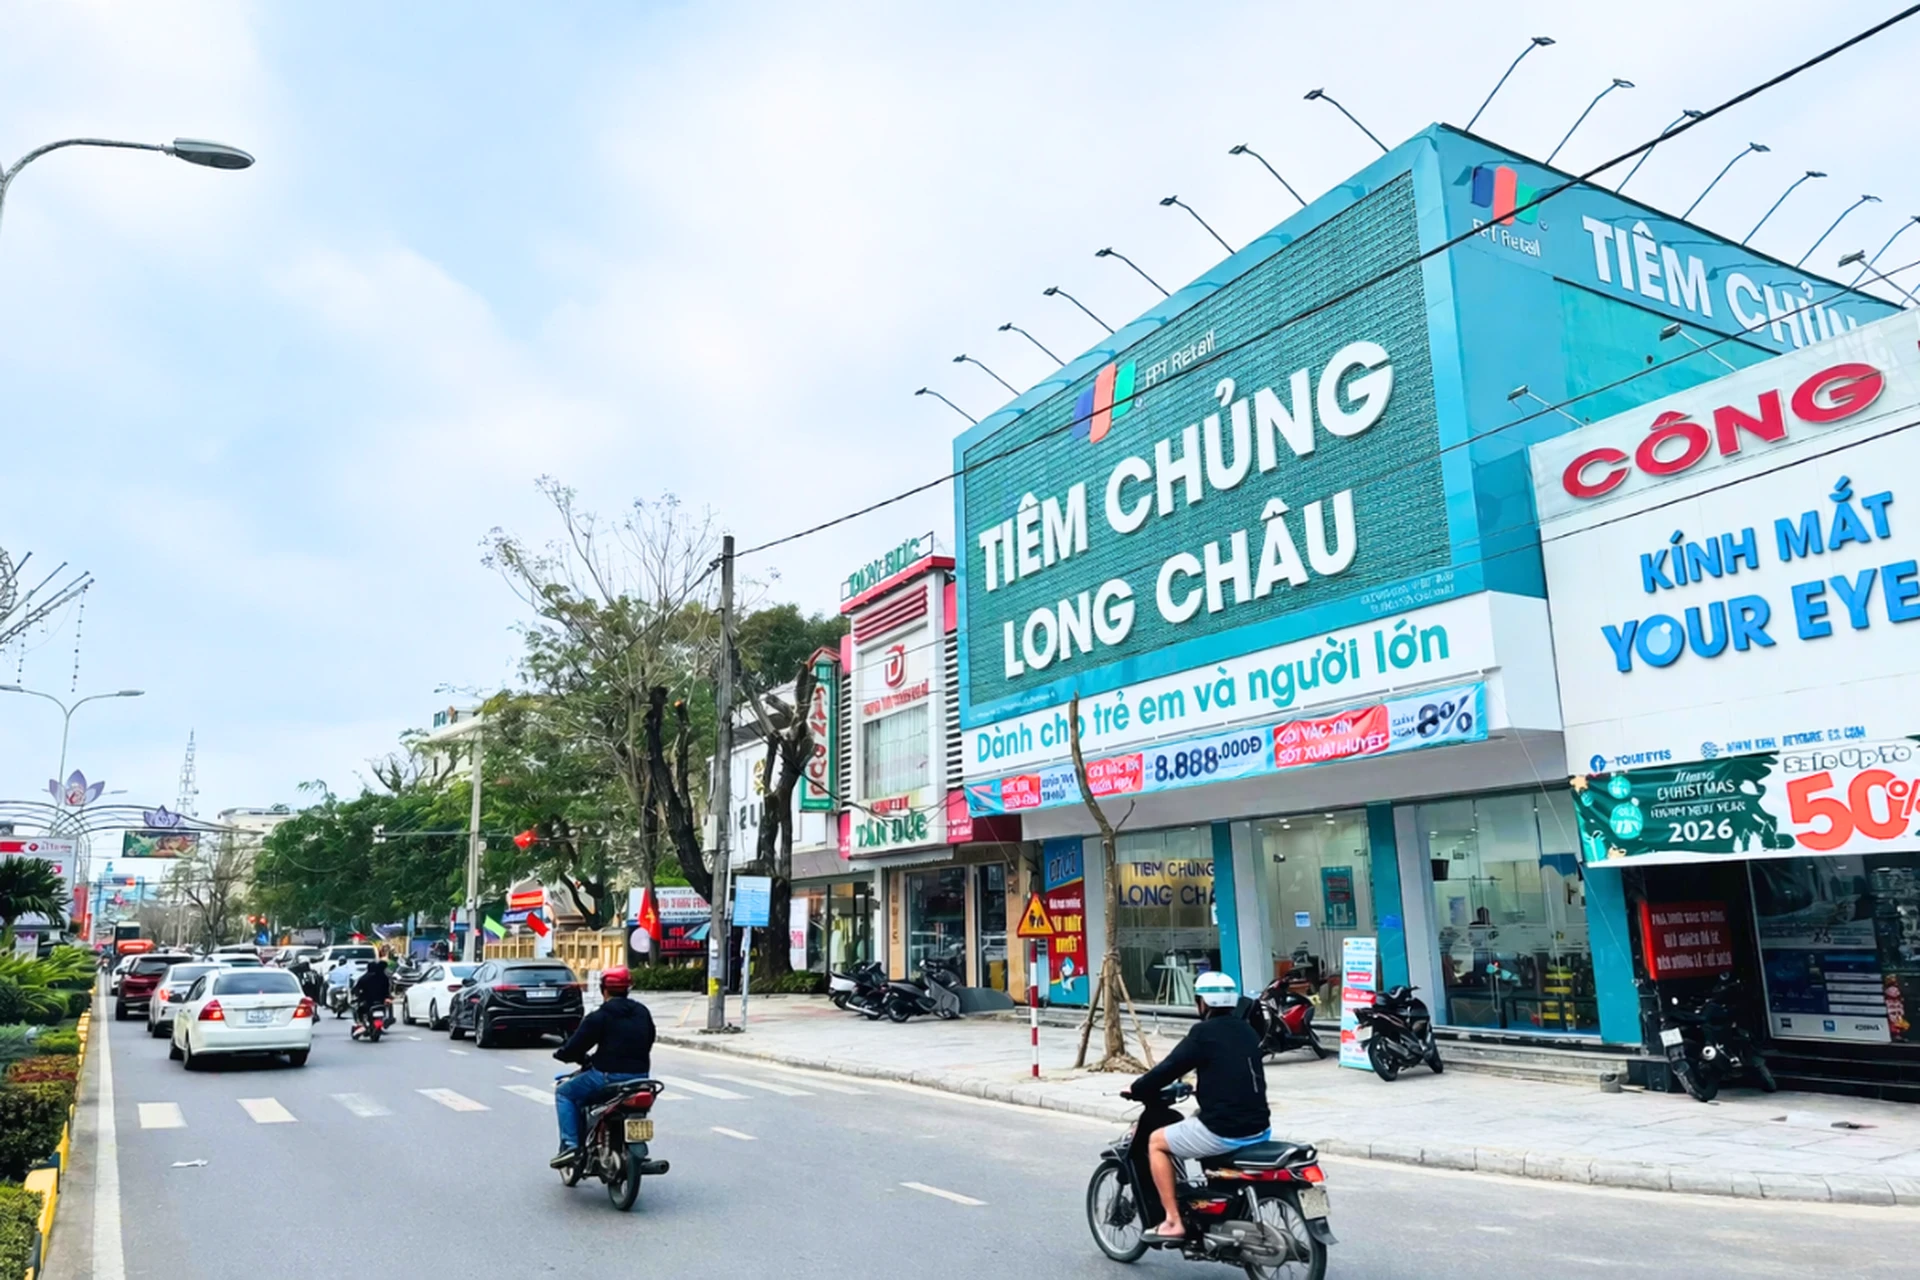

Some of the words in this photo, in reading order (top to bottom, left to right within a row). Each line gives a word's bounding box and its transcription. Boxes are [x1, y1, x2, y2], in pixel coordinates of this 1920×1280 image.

[1581, 219, 1713, 319] TIÊM
[979, 483, 1089, 593] TIÊM
[1105, 340, 1395, 534] CHỦNG
[1562, 362, 1886, 499] CÔNG
[1640, 527, 1759, 593] KÍNH
[1774, 475, 1894, 563] MẮT
[1003, 578, 1136, 681] LONG
[1155, 489, 1358, 625] CHÂU
[1601, 594, 1777, 673] YOUR
[977, 722, 1033, 764] Dành
[1040, 712, 1086, 748] cho
[1095, 693, 1129, 738] trẻ
[1139, 686, 1186, 725] em
[1195, 666, 1237, 713] và
[1248, 635, 1360, 708] người
[1375, 619, 1450, 675] lớn
[1416, 694, 1474, 739] 8%
[1667, 818, 1734, 843] 2026
[1785, 768, 1920, 852] 50%
[1118, 883, 1173, 906] LONG
